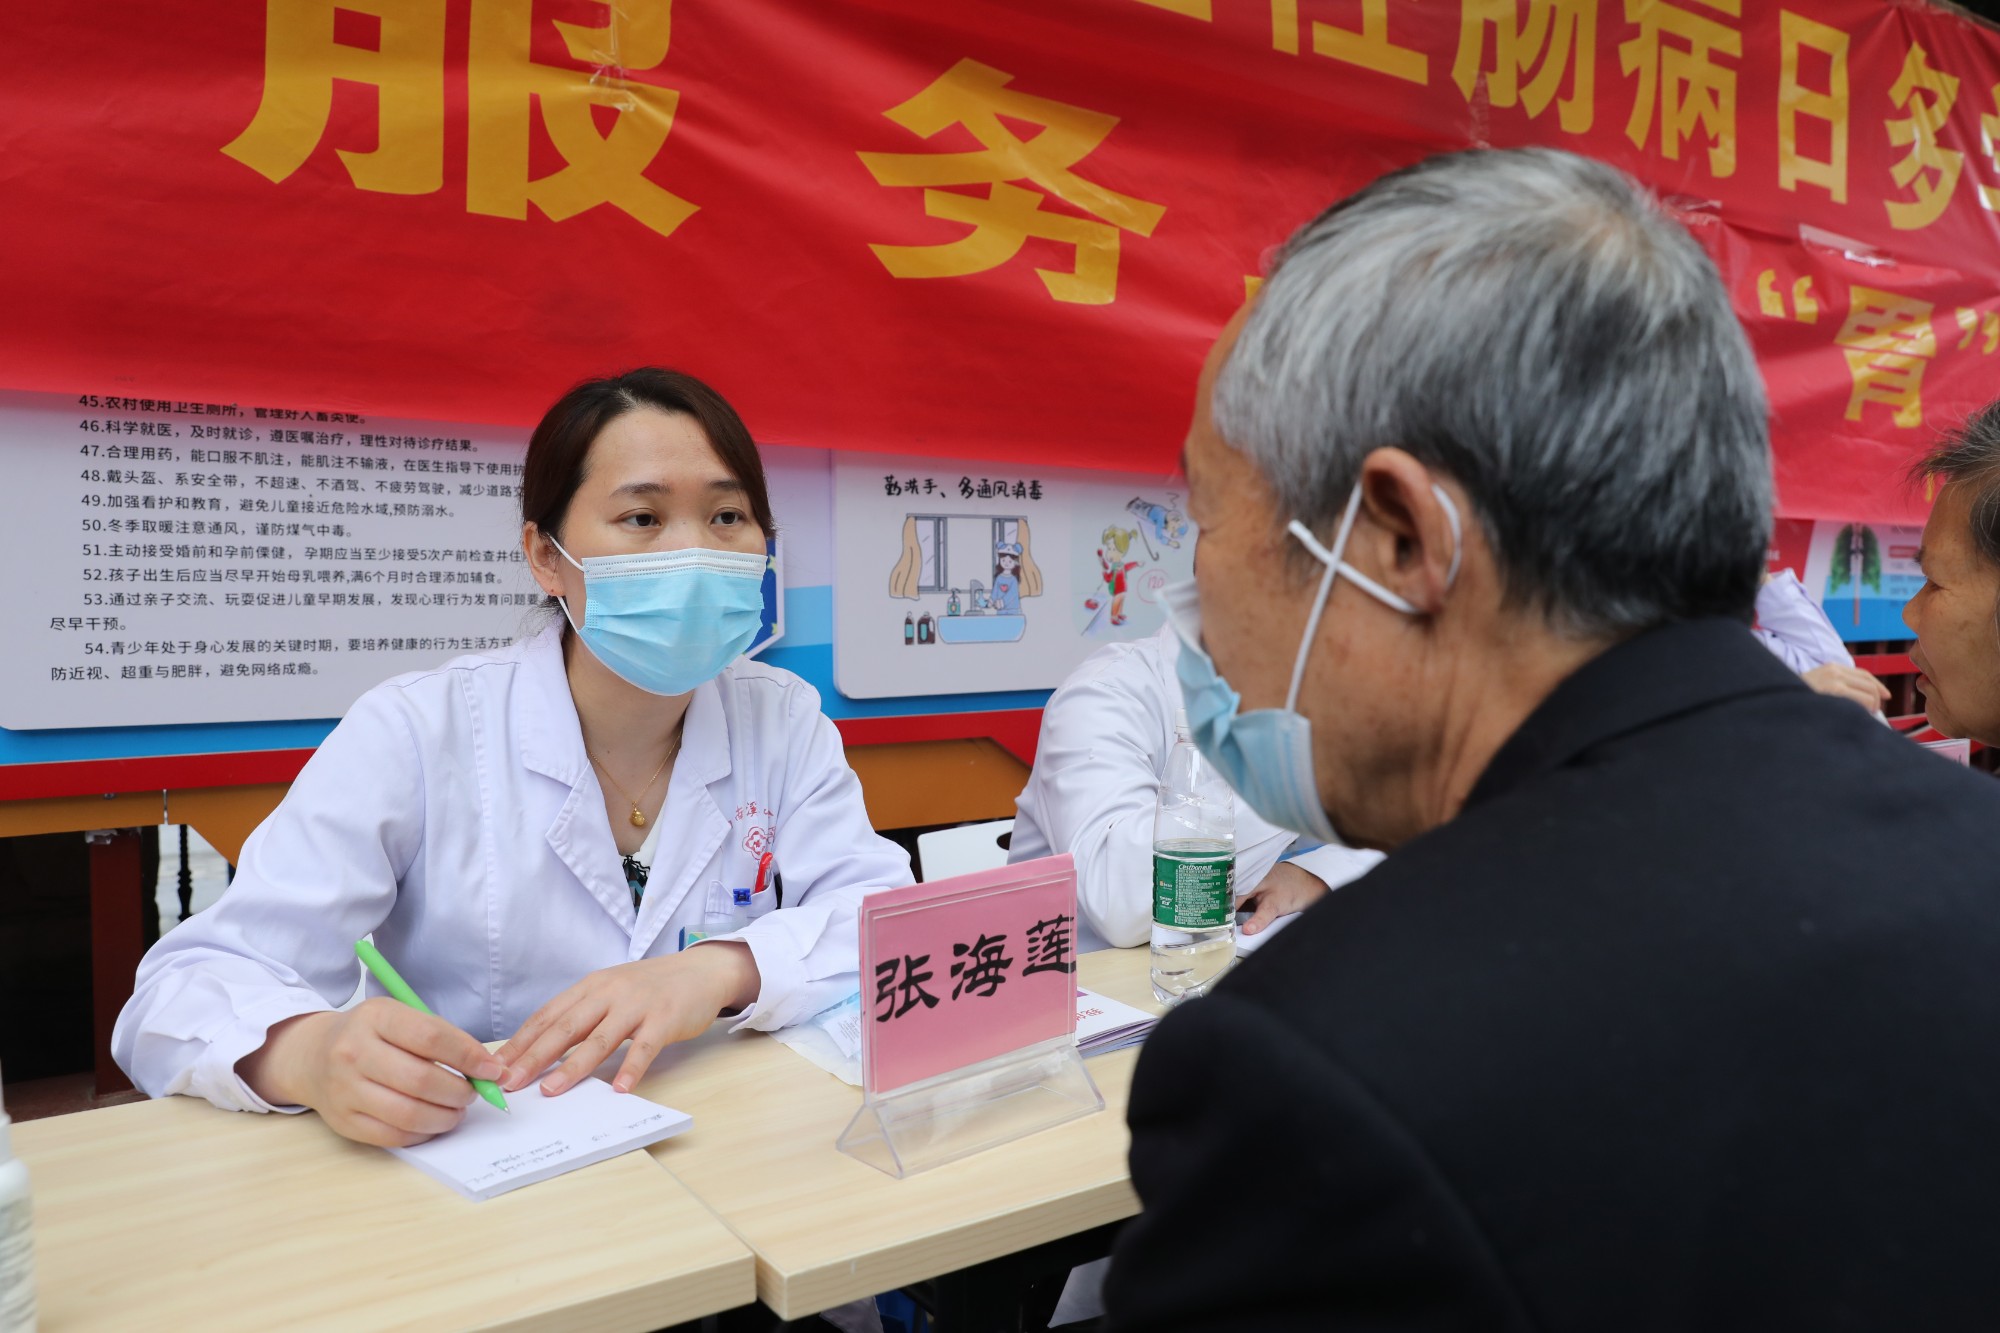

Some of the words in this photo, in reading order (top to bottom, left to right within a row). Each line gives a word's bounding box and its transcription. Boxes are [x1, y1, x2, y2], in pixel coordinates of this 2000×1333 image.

[79, 419, 478, 453] 46.科学就医，及时就诊，遵医嘱治疗，理性对待诊疗结果。
[82, 518, 352, 538] 50.冬季取暖注意通风，谨防煤气中毒。
[50, 617, 127, 632] 尽早干预。
[51, 662, 318, 682] 防近视、超重与肥胖，避免网络成瘾。
[875, 913, 1077, 1023] 张海莲
